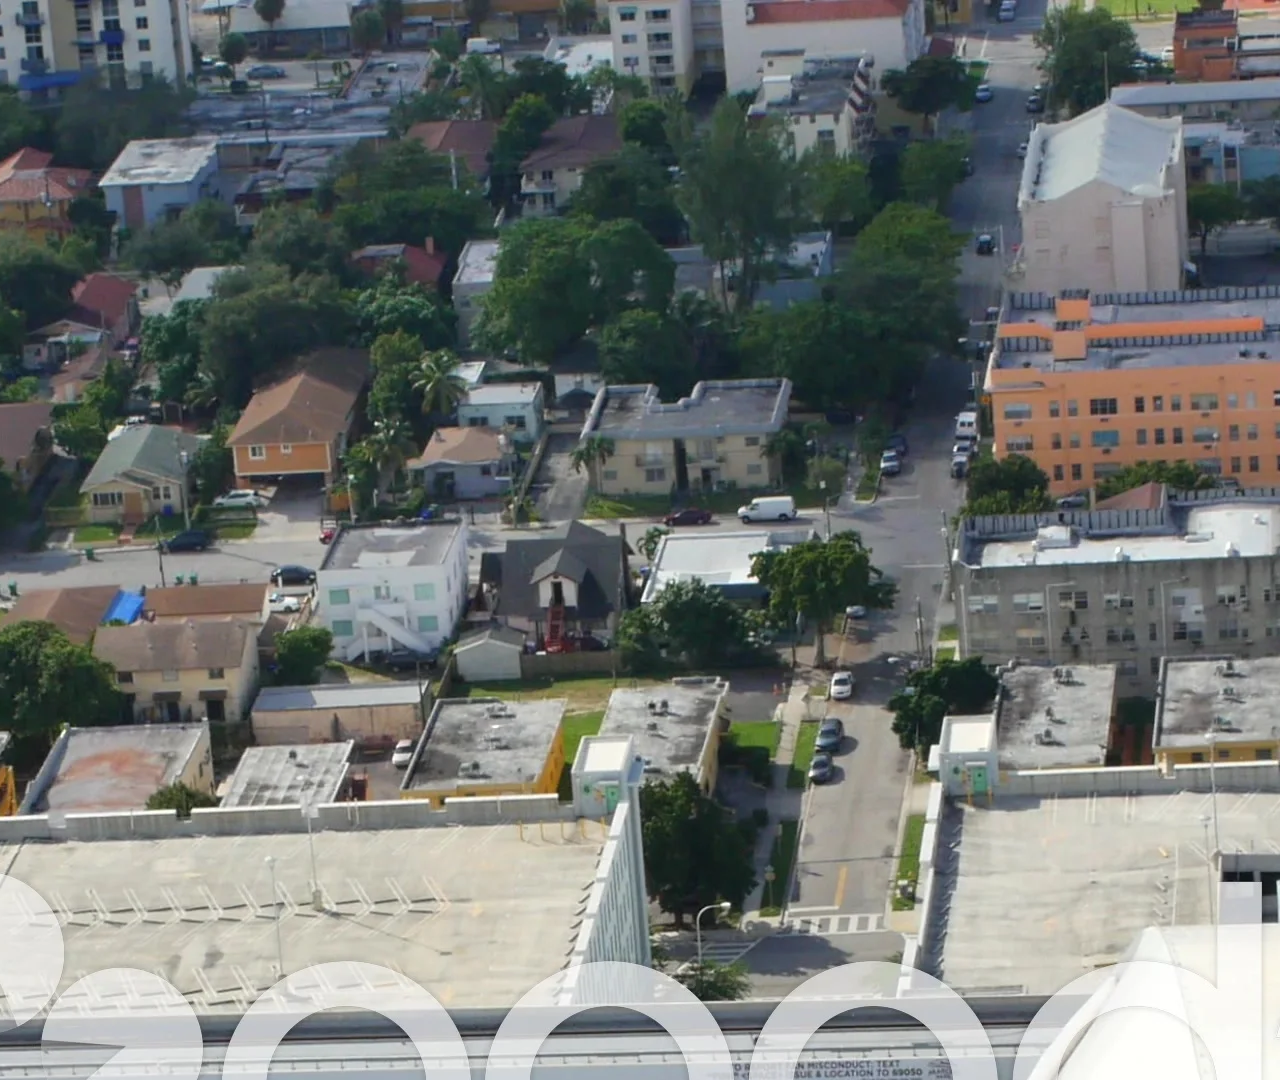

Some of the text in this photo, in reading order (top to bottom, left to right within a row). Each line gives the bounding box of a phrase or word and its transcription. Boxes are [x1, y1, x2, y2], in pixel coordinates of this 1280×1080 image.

[876, 1060, 900, 1068] TEXT
[824, 1069, 873, 1078] LOCATION
[877, 1068, 890, 1077] TO
